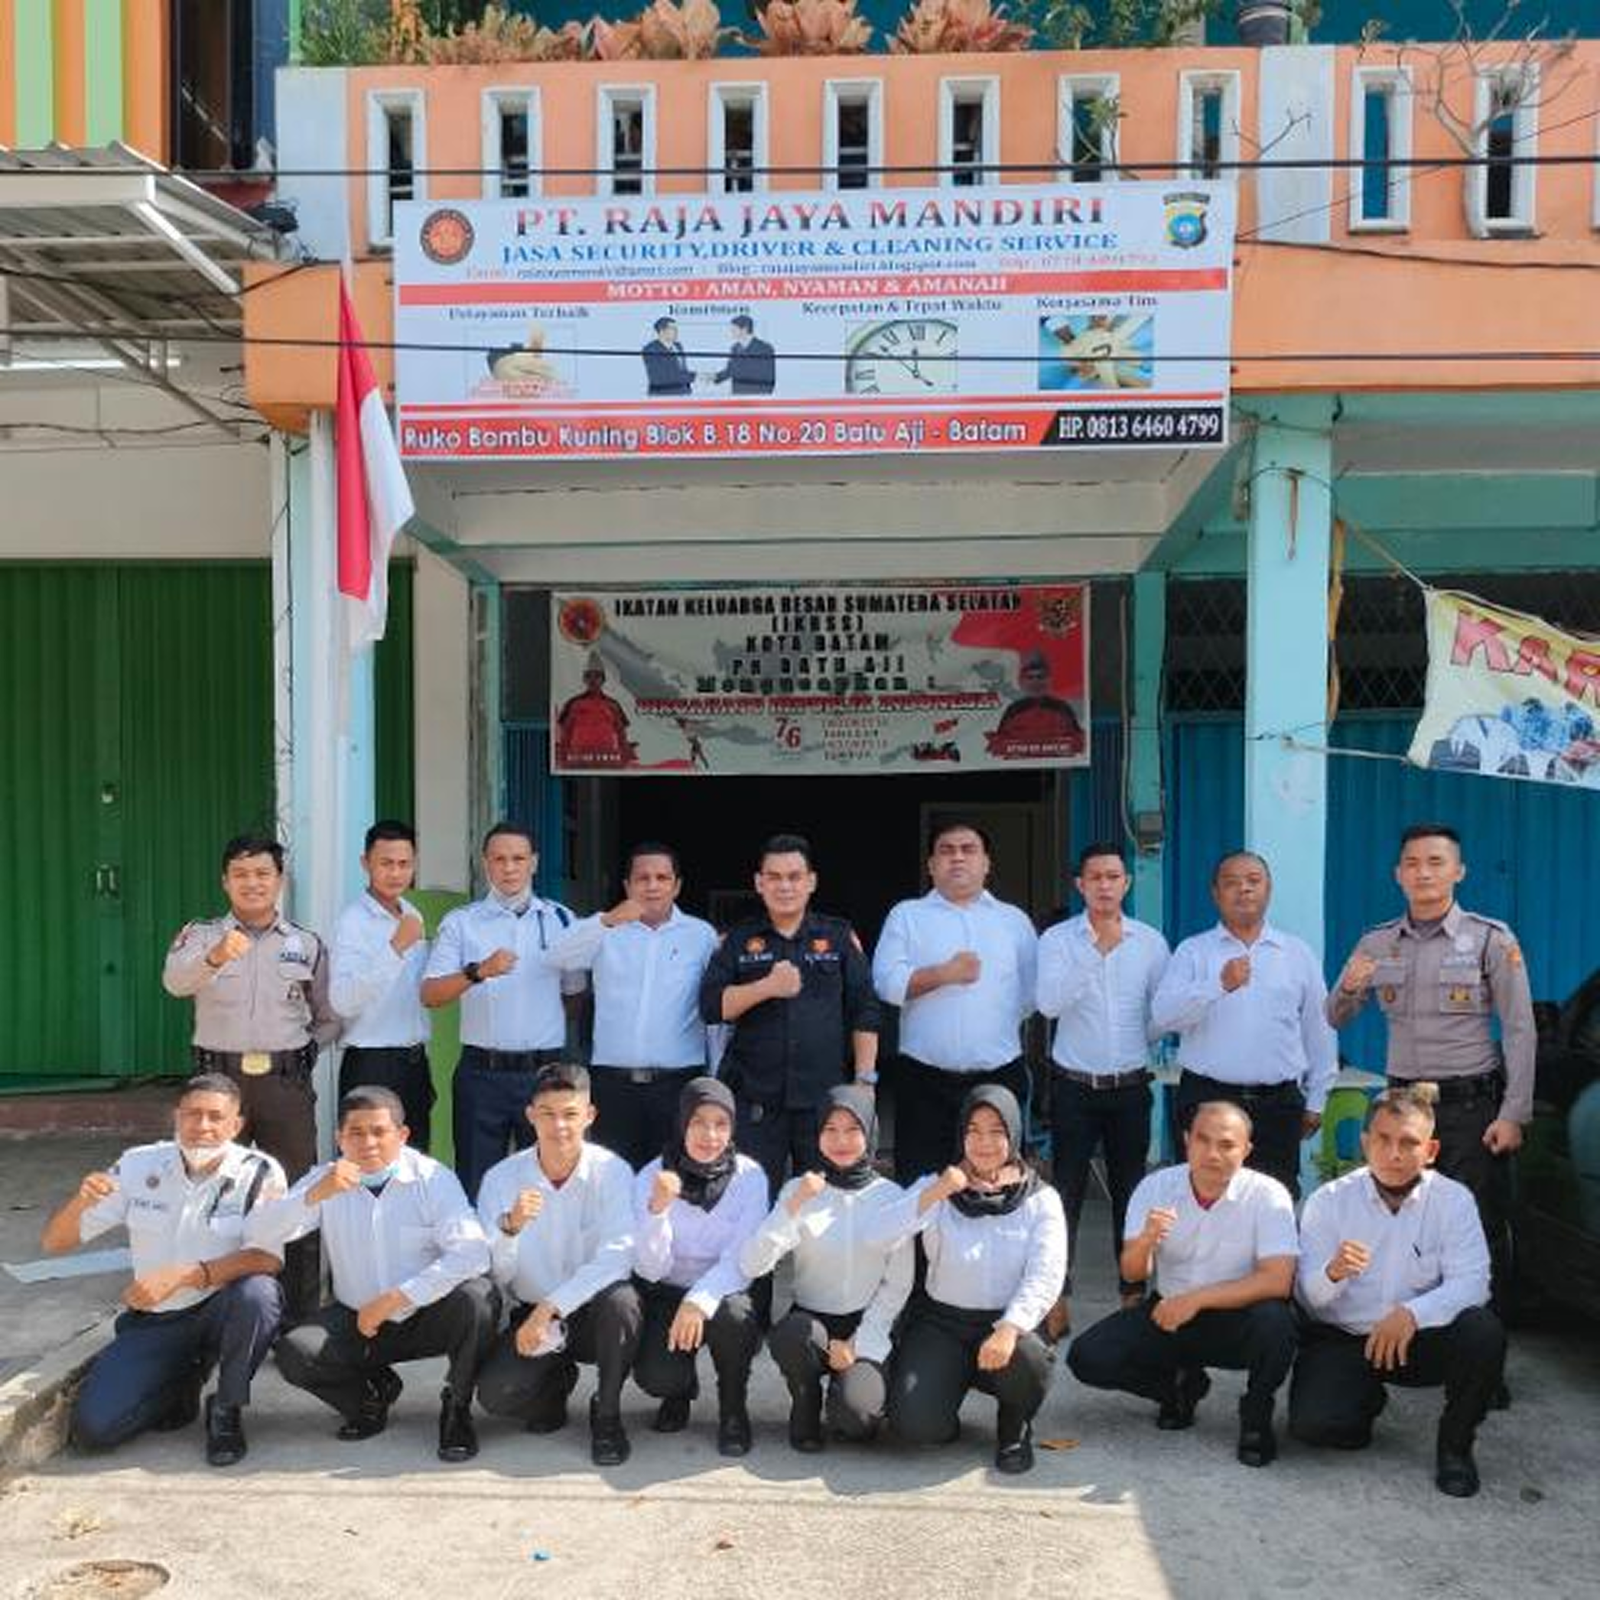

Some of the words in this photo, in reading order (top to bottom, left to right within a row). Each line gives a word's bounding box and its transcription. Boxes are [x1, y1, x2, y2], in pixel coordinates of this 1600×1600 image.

[515, 207, 586, 236] PT.
[605, 203, 724, 240] RAJA
[740, 200, 850, 238] JAYA
[869, 196, 1105, 229] MANDIRI
[503, 244, 562, 264] JASA
[823, 238, 844, 255] &
[852, 235, 994, 256] CLEANING
[1000, 231, 1119, 251] SERVICE
[607, 282, 689, 299] MOTTO
[706, 280, 778, 298] AMAN,
[783, 277, 885, 296] NYAMAN
[889, 276, 900, 293] &
[907, 273, 1007, 294] AMANAH
[532, 304, 590, 319] Terbaik
[802, 301, 883, 318] Kecepatan
[904, 298, 946, 317] Tepat
[950, 296, 1002, 314] Waktu
[1036, 295, 1121, 312] Kerjasama
[1127, 293, 1158, 307] Tim
[404, 426, 461, 449] Ruko
[469, 423, 550, 448] Bambu
[559, 423, 639, 450] Kuning
[646, 424, 695, 446] Blok
[834, 421, 886, 442] Batu
[894, 420, 925, 449] Aji
[949, 419, 1026, 441] Batam
[1059, 416, 1084, 438] HP.
[1087, 416, 1129, 438] 0813
[1131, 414, 1174, 437] 6460
[1177, 413, 1219, 436] 4799
[616, 598, 680, 617] IKATAN
[685, 596, 776, 616] KELUARGA
[781, 594, 837, 614] BESAR
[845, 591, 941, 613] SUMATERA
[747, 634, 801, 653] KOTA
[815, 633, 889, 651] BATAM
[775, 716, 802, 748] 76
